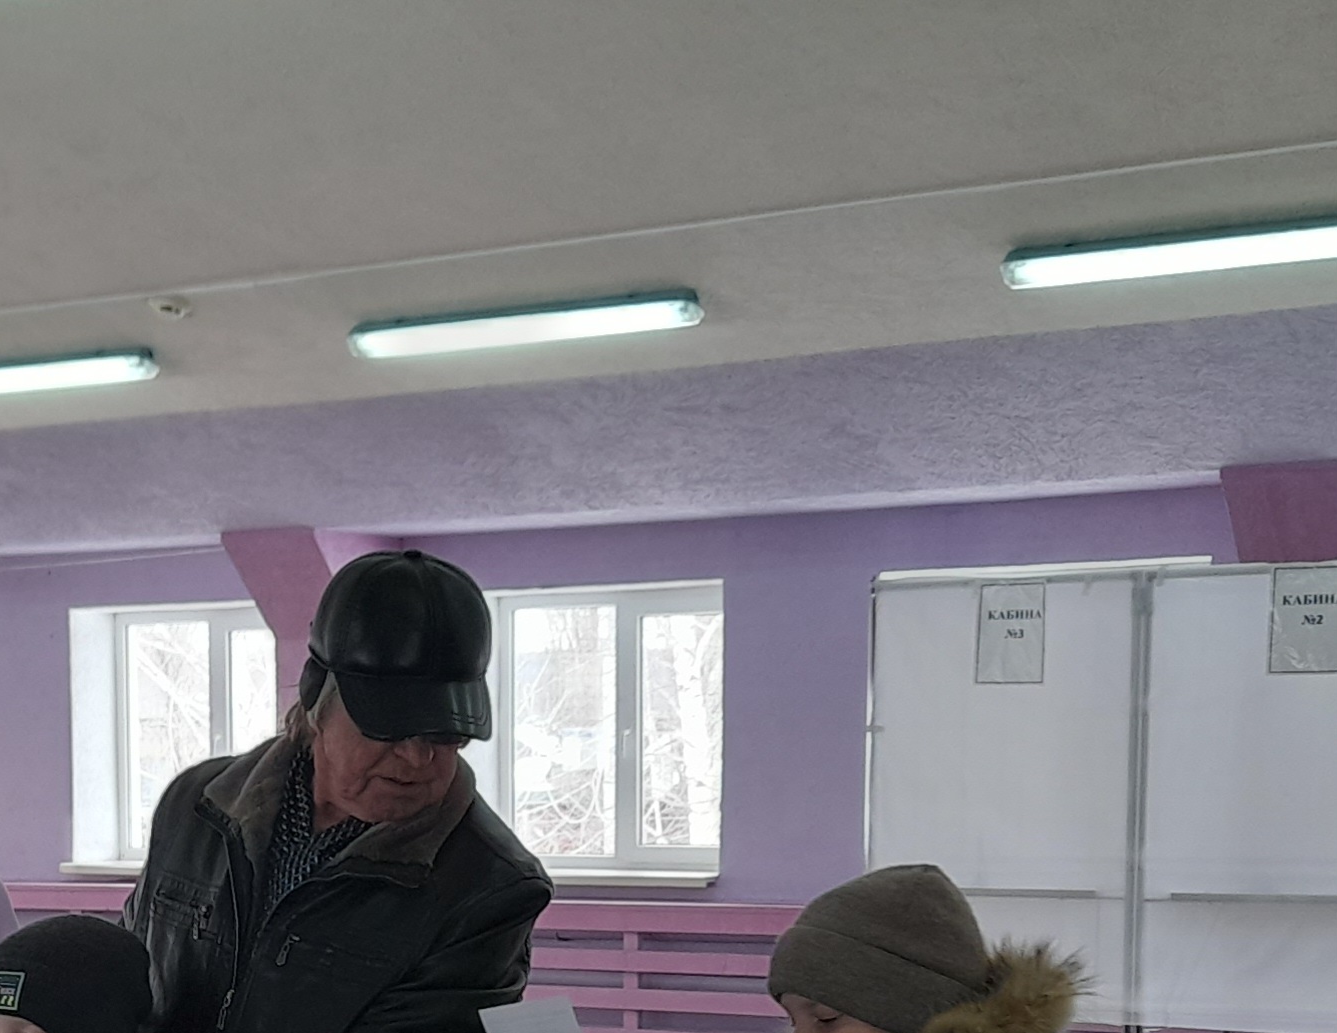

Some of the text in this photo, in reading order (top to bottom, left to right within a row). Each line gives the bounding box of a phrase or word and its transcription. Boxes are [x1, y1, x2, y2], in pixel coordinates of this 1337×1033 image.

[1282, 593, 1337, 606] КАБИН
[988, 608, 1043, 621] КАБИНА
[1301, 614, 1324, 626] №2
[1004, 628, 1025, 640] №3
